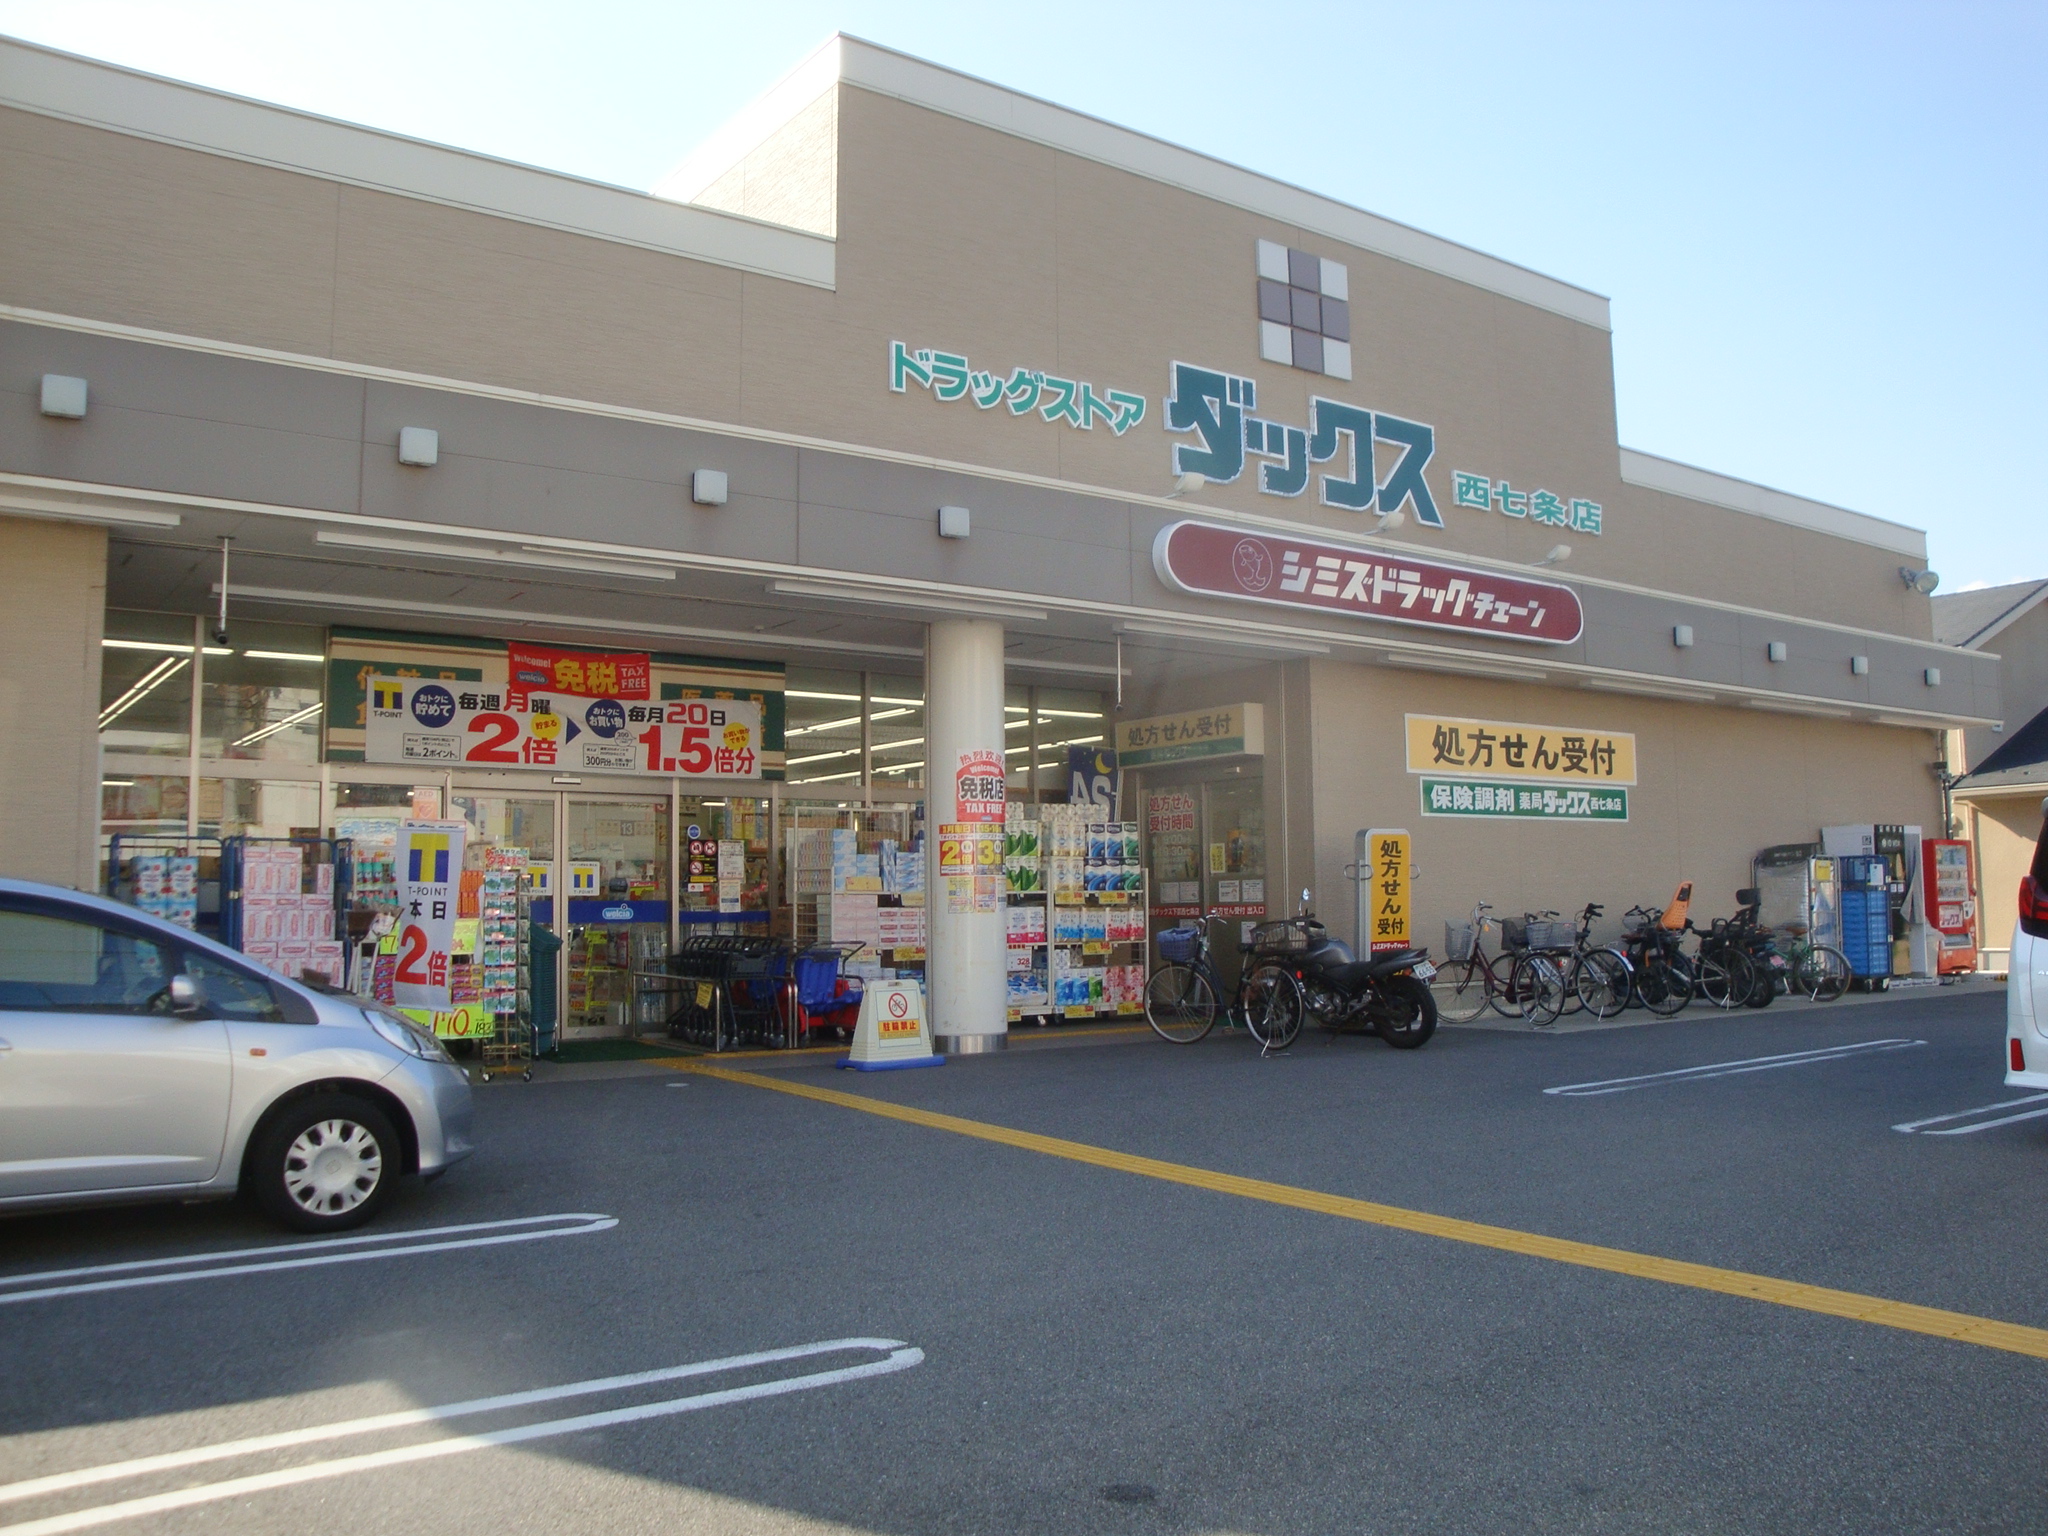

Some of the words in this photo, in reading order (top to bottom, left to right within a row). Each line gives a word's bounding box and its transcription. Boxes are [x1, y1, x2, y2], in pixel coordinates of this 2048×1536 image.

[889, 340, 1147, 437] ドラッグストア
[1164, 359, 1445, 529] ダックス
[1451, 470, 1602, 536] 西七条店
[1280, 550, 1547, 628] シミズドラッグチェーン
[554, 659, 619, 694] 免税
[621, 666, 644, 677] TAX
[621, 678, 646, 689] FREE
[419, 694, 449, 704] おトクに
[459, 689, 551, 715] 毎週月曜
[373, 710, 403, 719] T-POINT
[415, 702, 452, 717] 貯めて
[592, 707, 620, 716] おトクに
[627, 702, 726, 726] 毎月20日
[535, 719, 557, 730] 貯まる
[588, 715, 624, 729] お買い物
[1128, 714, 1232, 747] 処方せん受付
[465, 712, 558, 765] 2倍
[730, 735, 746, 744] できる
[638, 724, 756, 775] 1.5倍分
[1432, 724, 1616, 776] 処方せん受付
[960, 776, 1004, 800] 免税店
[965, 803, 985, 813] TAX
[986, 803, 1002, 814] FREE
[1149, 794, 1194, 812] 処方せん
[1430, 784, 1514, 812] 保険調剤
[1518, 789, 1623, 815] 薬局ダックス西七条店
[1149, 813, 1194, 832] 受付時間
[408, 886, 448, 897] T-POINT
[1377, 840, 1404, 936] 処方せん受付
[409, 899, 447, 920] 本日
[605, 908, 631, 918] welcia
[394, 924, 448, 987] 2倍
[883, 1021, 917, 1032] 駐輪禁止
